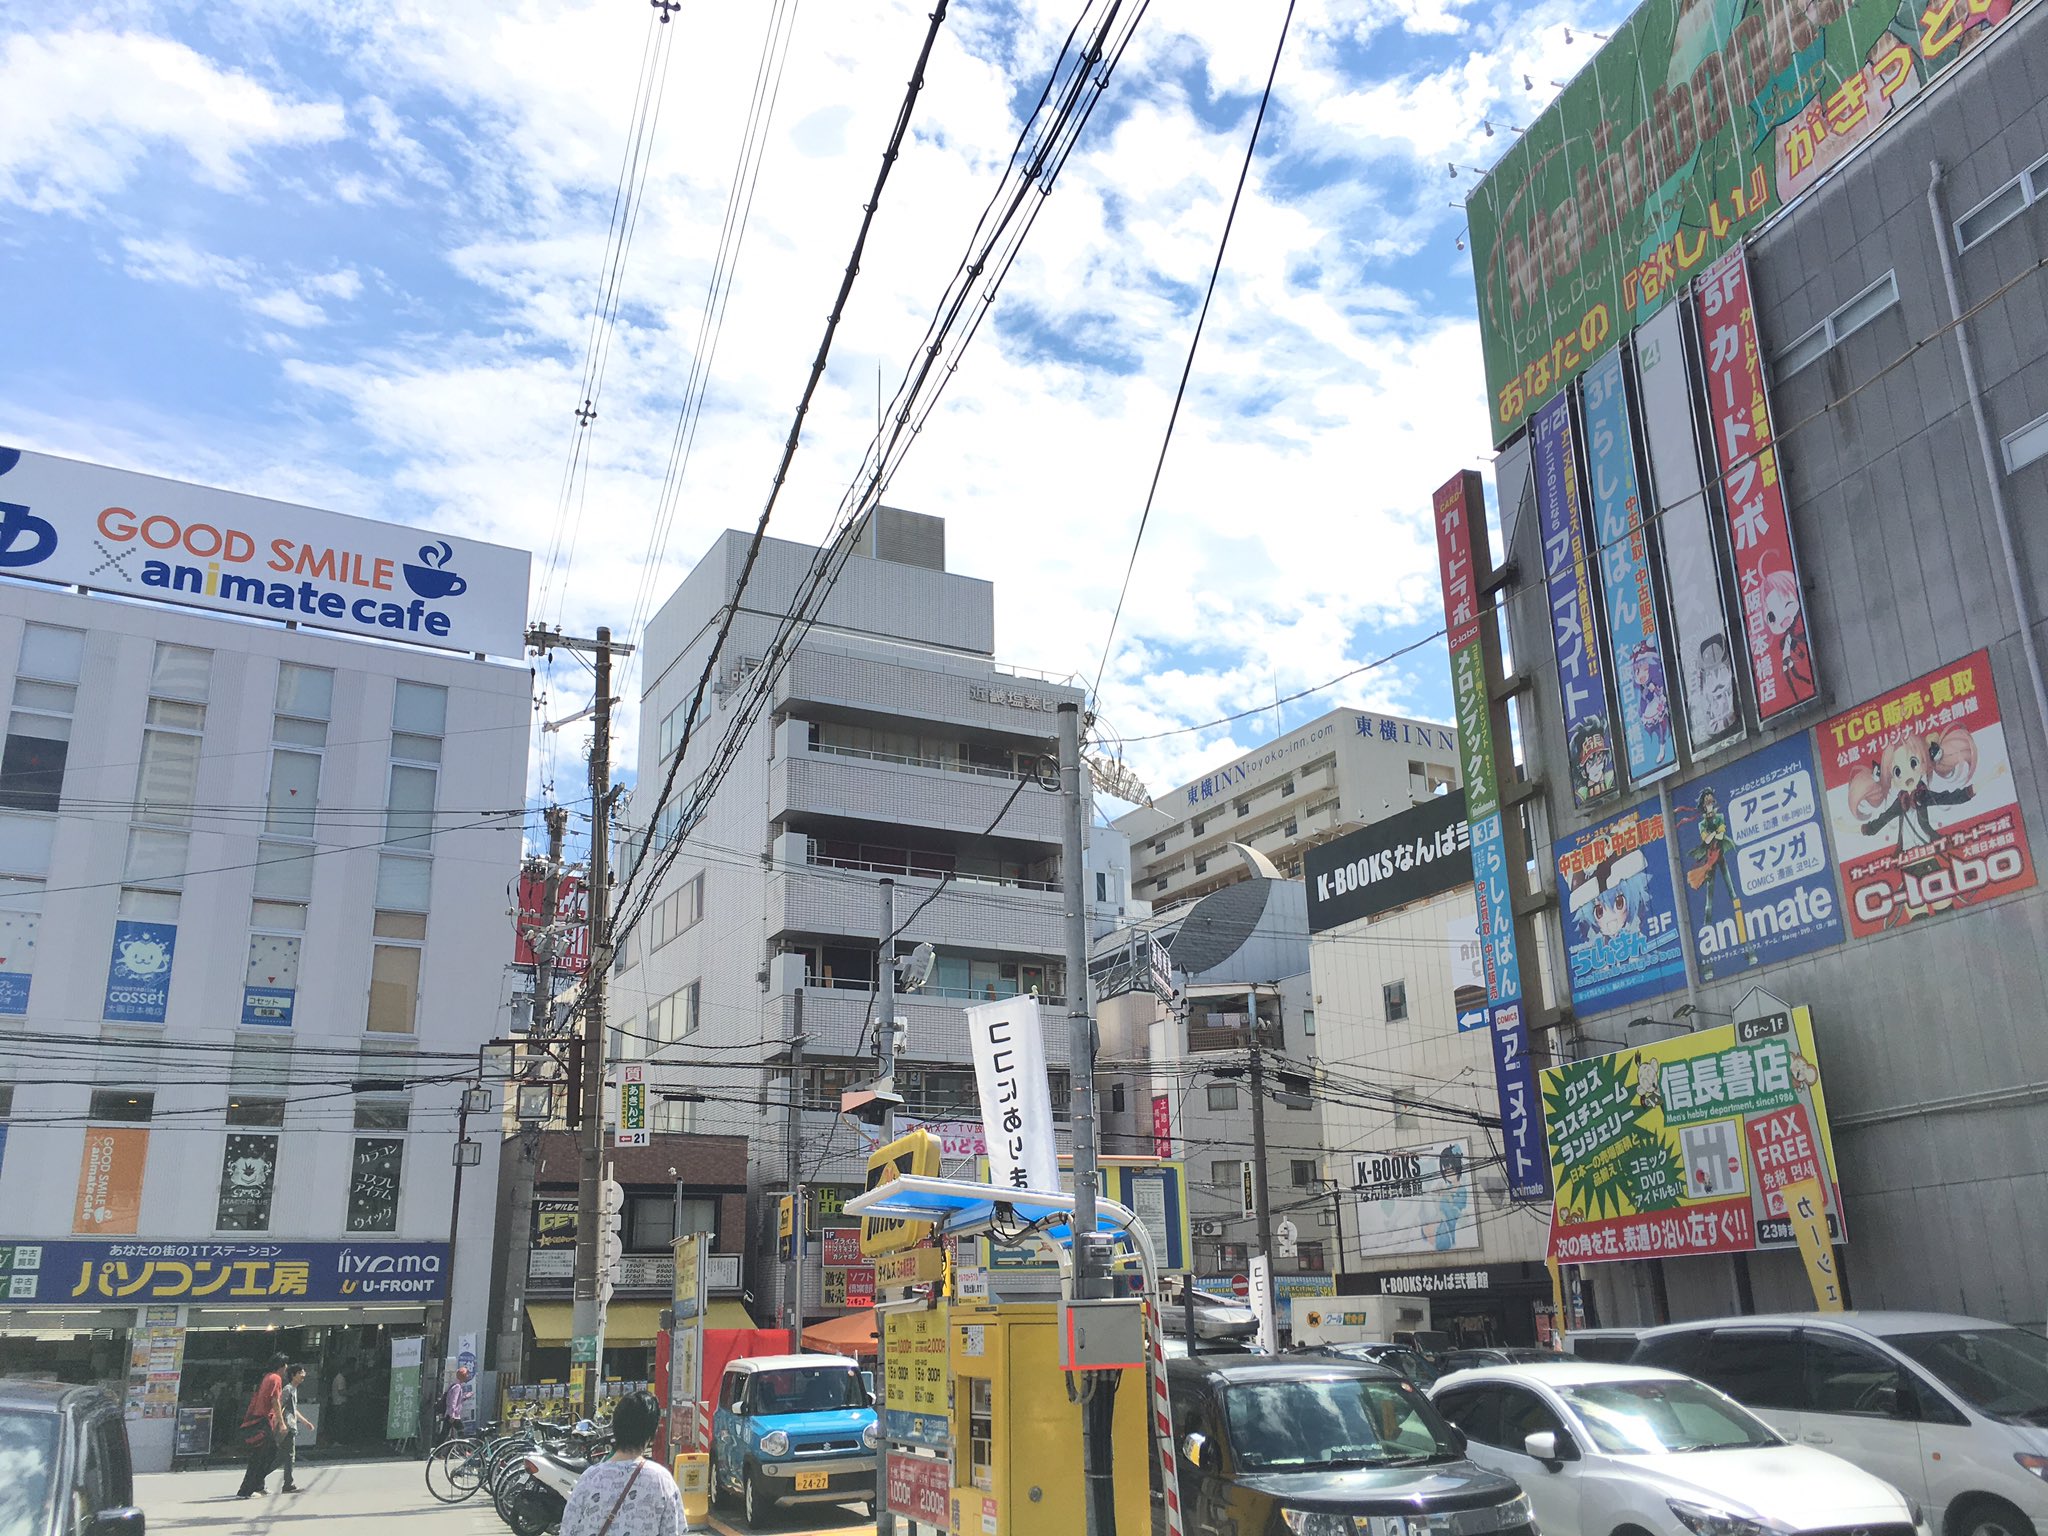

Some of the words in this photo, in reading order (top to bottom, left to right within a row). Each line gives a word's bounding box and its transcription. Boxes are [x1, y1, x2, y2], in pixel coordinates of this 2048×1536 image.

[1506, 0, 1842, 322] Melonbook
[1499, 303, 1610, 424] あなたの
[1785, 0, 1994, 181] がきっと
[1704, 262, 1742, 318] 5F
[1588, 368, 1619, 411] 3F
[1534, 402, 1569, 446] 1F/2F
[1709, 324, 1770, 550] カードラボ
[1544, 440, 1561, 531] アニメのことなら
[1593, 418, 1638, 632] らしんばん
[97, 506, 256, 564] GOOD
[266, 538, 396, 592] SMILE
[1624, 495, 1656, 636] 中古買取・中古販売
[1442, 507, 1473, 627] カードラボ
[1450, 625, 1479, 650] C-labo
[1545, 527, 1590, 721] アニメイト
[1741, 567, 1778, 705] 大阪日本橋店
[970, 685, 1055, 713] 近畿塩業ビ
[1616, 642, 1646, 765] 大阪日本橋店
[1354, 715, 1455, 752] 東横INN
[1458, 650, 1487, 800] メロンブックス
[1836, 697, 1979, 768] 公認・オリジナル大会開催
[1186, 761, 1247, 807] 東横INN
[1245, 722, 1335, 774] toyoko-inn.com
[1741, 780, 1799, 823] アニメ
[1477, 823, 1496, 843] 3F
[1558, 813, 1666, 878] 中古買取・中古販売
[1736, 825, 1760, 841] ANIME
[1952, 814, 2013, 847] カードラボ
[1962, 832, 2016, 858] 大阪日本橋店
[1749, 831, 1807, 872] マンガ
[1746, 872, 1775, 891] COMICS
[1854, 846, 2025, 924] C-labo
[1487, 845, 1517, 999] らしんばん
[1647, 910, 1672, 938] 3F
[1698, 886, 1833, 957] animate
[1477, 880, 1500, 1001] 中古買取・中古販売
[107, 1004, 164, 1016] 大阪日本橋店
[109, 990, 165, 1006] cosset
[249, 997, 279, 1006] コセット
[1496, 1012, 1518, 1026] COMICS
[626, 1066, 642, 1082] 質
[1565, 1065, 1603, 1107] グッズ
[1660, 1043, 1790, 1112] 信長書店
[627, 1085, 639, 1128] あきんど
[1502, 1032, 1532, 1178] アニメイト
[1553, 1081, 1629, 1142] コスチューム
[1666, 1113, 1686, 1123] Men's
[1709, 1102, 1755, 1116] department,
[633, 1133, 646, 1144] 21
[1560, 1109, 1635, 1166] ランジェリー
[1754, 1111, 1802, 1145] TAX
[100, 1136, 115, 1173] GOOD
[358, 1145, 398, 1165] カラコン
[1630, 1149, 1667, 1175] コミック
[1757, 1134, 1812, 1171] FREE
[357, 1171, 395, 1189] コスプレ
[1357, 1156, 1421, 1184] K-BOOKS
[1640, 1169, 1666, 1190] DVD
[1763, 1168, 1788, 1191] 免税
[1790, 1160, 1817, 1182] 면세
[95, 1174, 109, 1205] SMILE
[354, 1182, 392, 1200] アイテム
[820, 1189, 835, 1199] 1F
[1512, 1181, 1544, 1199] animate
[1634, 1181, 1683, 1208] アイドルも!!
[109, 1244, 282, 1258] あなたの街のITステーション
[825, 1231, 835, 1239] 1F
[20, 1249, 38, 1258] 中古
[14, 1278, 33, 1286] 中古
[71, 1261, 311, 1298] パソコン工房
[362, 1279, 435, 1293] U-FRONT
[825, 1271, 845, 1287] 激安
[850, 1273, 874, 1282] ソフト
[824, 1289, 845, 1304] 販売
[920, 1488, 945, 1517] 2,000円
